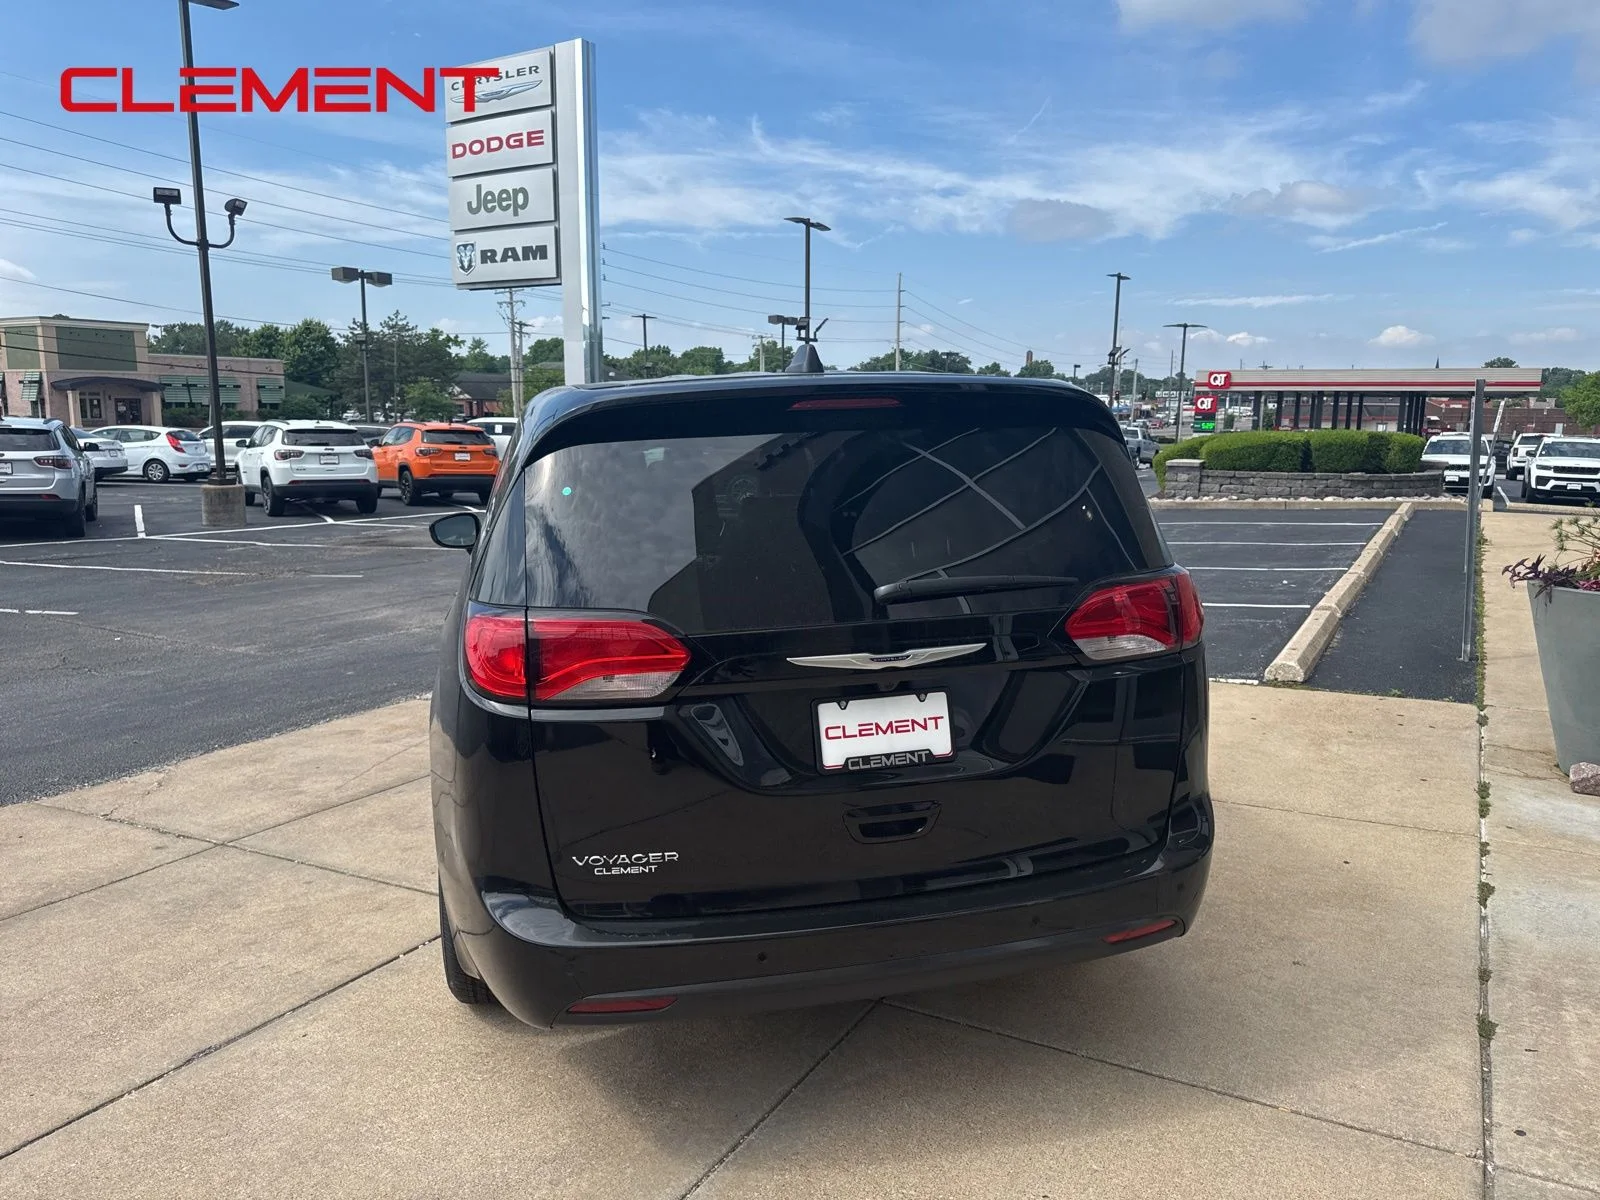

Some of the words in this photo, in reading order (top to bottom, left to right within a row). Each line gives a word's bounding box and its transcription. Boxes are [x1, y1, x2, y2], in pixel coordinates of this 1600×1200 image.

[451, 65, 540, 91] CRYSLER
[452, 130, 545, 160] DODGE
[467, 183, 529, 217] Jeep
[480, 245, 548, 264] RAM
[1210, 373, 1227, 387] QT
[1197, 397, 1214, 410] QT
[824, 715, 944, 741] CLEMENT
[848, 750, 930, 771] CLEMENT
[571, 851, 679, 866] VOYAGER
[594, 865, 658, 875] CLEMENT
